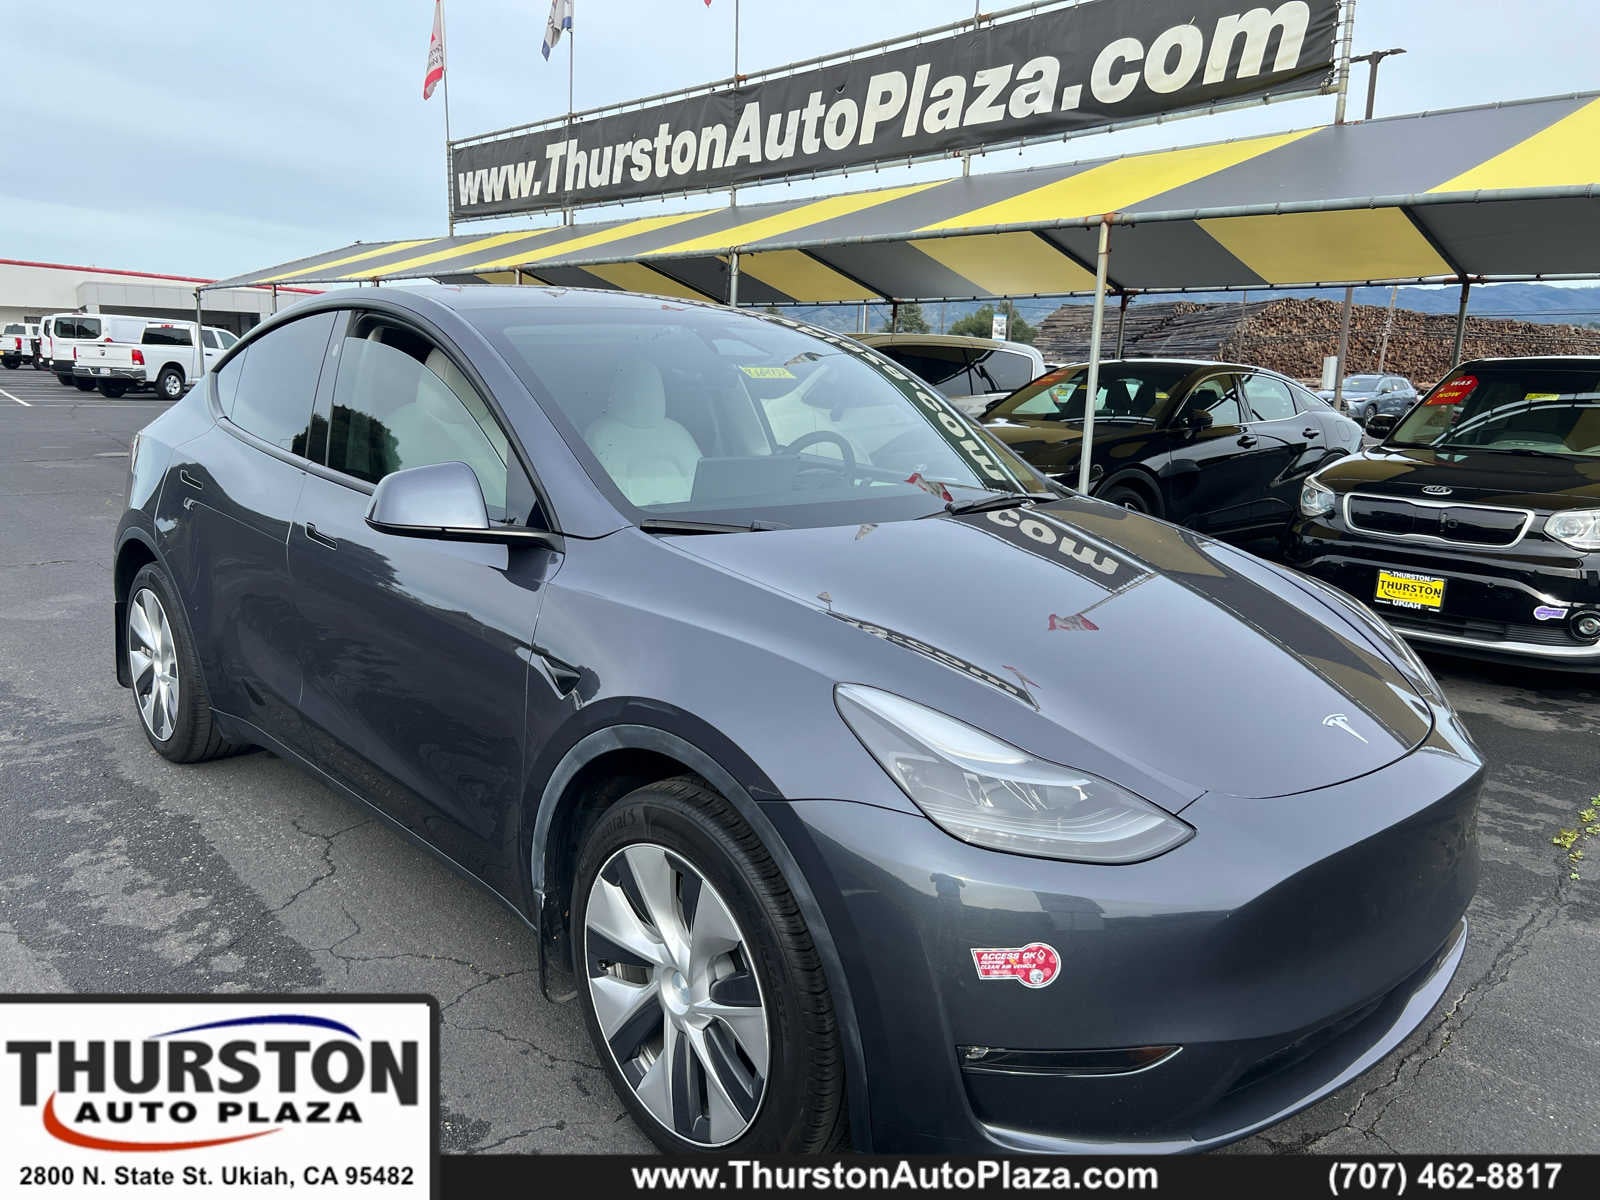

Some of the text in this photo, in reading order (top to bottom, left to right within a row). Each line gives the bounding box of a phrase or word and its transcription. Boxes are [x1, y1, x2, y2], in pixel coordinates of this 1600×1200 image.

[458, 0, 1310, 206] www.ThurstonAutoPlaza.com
[1450, 379, 1473, 387] WAS
[1393, 571, 1430, 582] THURSTON
[1380, 580, 1442, 598] THURSTON
[1392, 600, 1421, 609] UKIAH
[981, 951, 1036, 960] ACCESS OK
